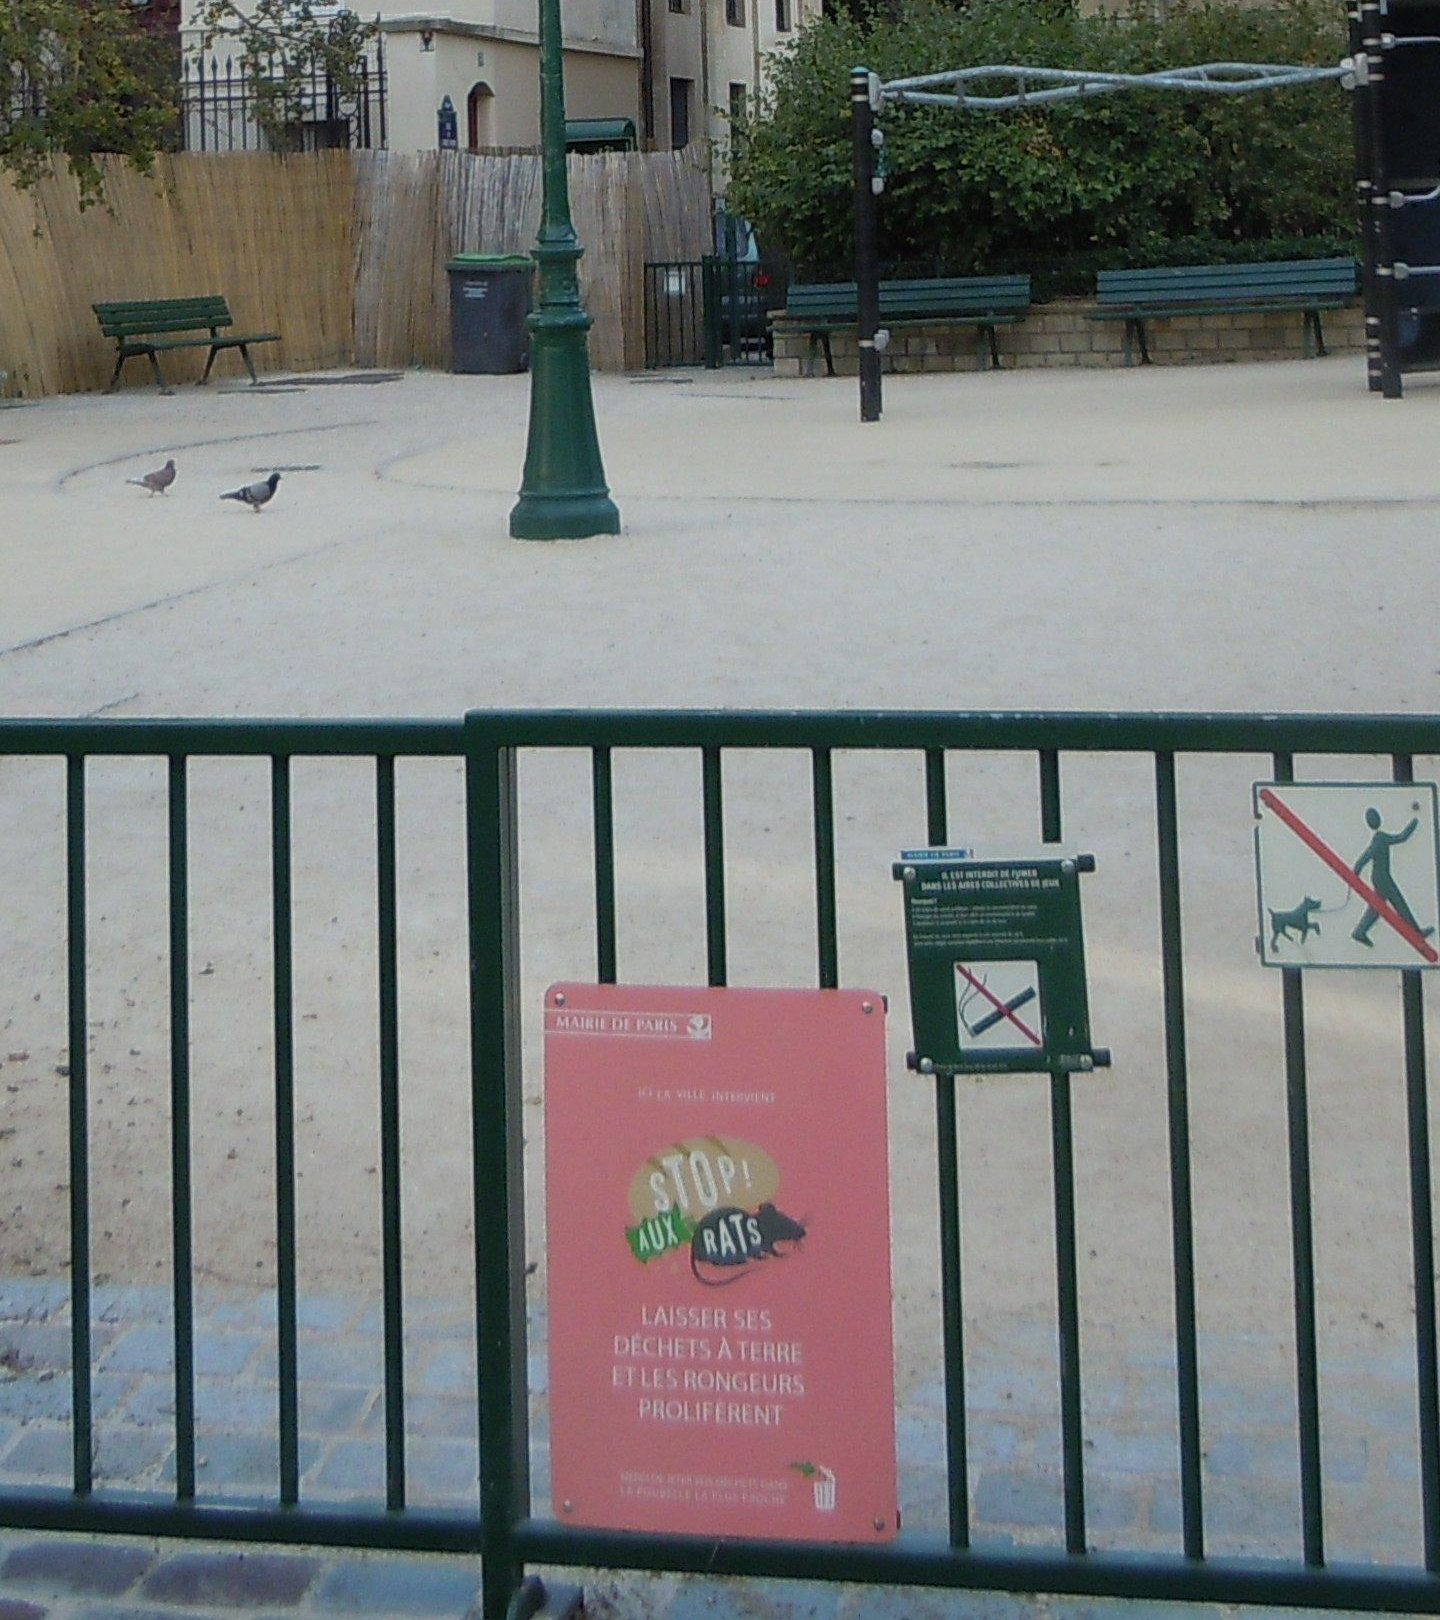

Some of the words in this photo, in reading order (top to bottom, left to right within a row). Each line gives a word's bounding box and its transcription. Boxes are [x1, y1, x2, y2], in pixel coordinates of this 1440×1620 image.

[556, 1015, 606, 1031] MAIRIE
[612, 1017, 629, 1031] DE
[636, 1018, 679, 1033] PARIS
[638, 1215, 679, 1253] AUX
[702, 1213, 762, 1257] RATS
[641, 1305, 728, 1329] LAISSER
[733, 1309, 772, 1331] SES
[614, 1332, 711, 1359] DÉCHETS
[737, 1340, 803, 1365] TERRE
[612, 1365, 637, 1387] ET
[641, 1367, 678, 1390] LES
[684, 1369, 806, 1395] RONGEURS
